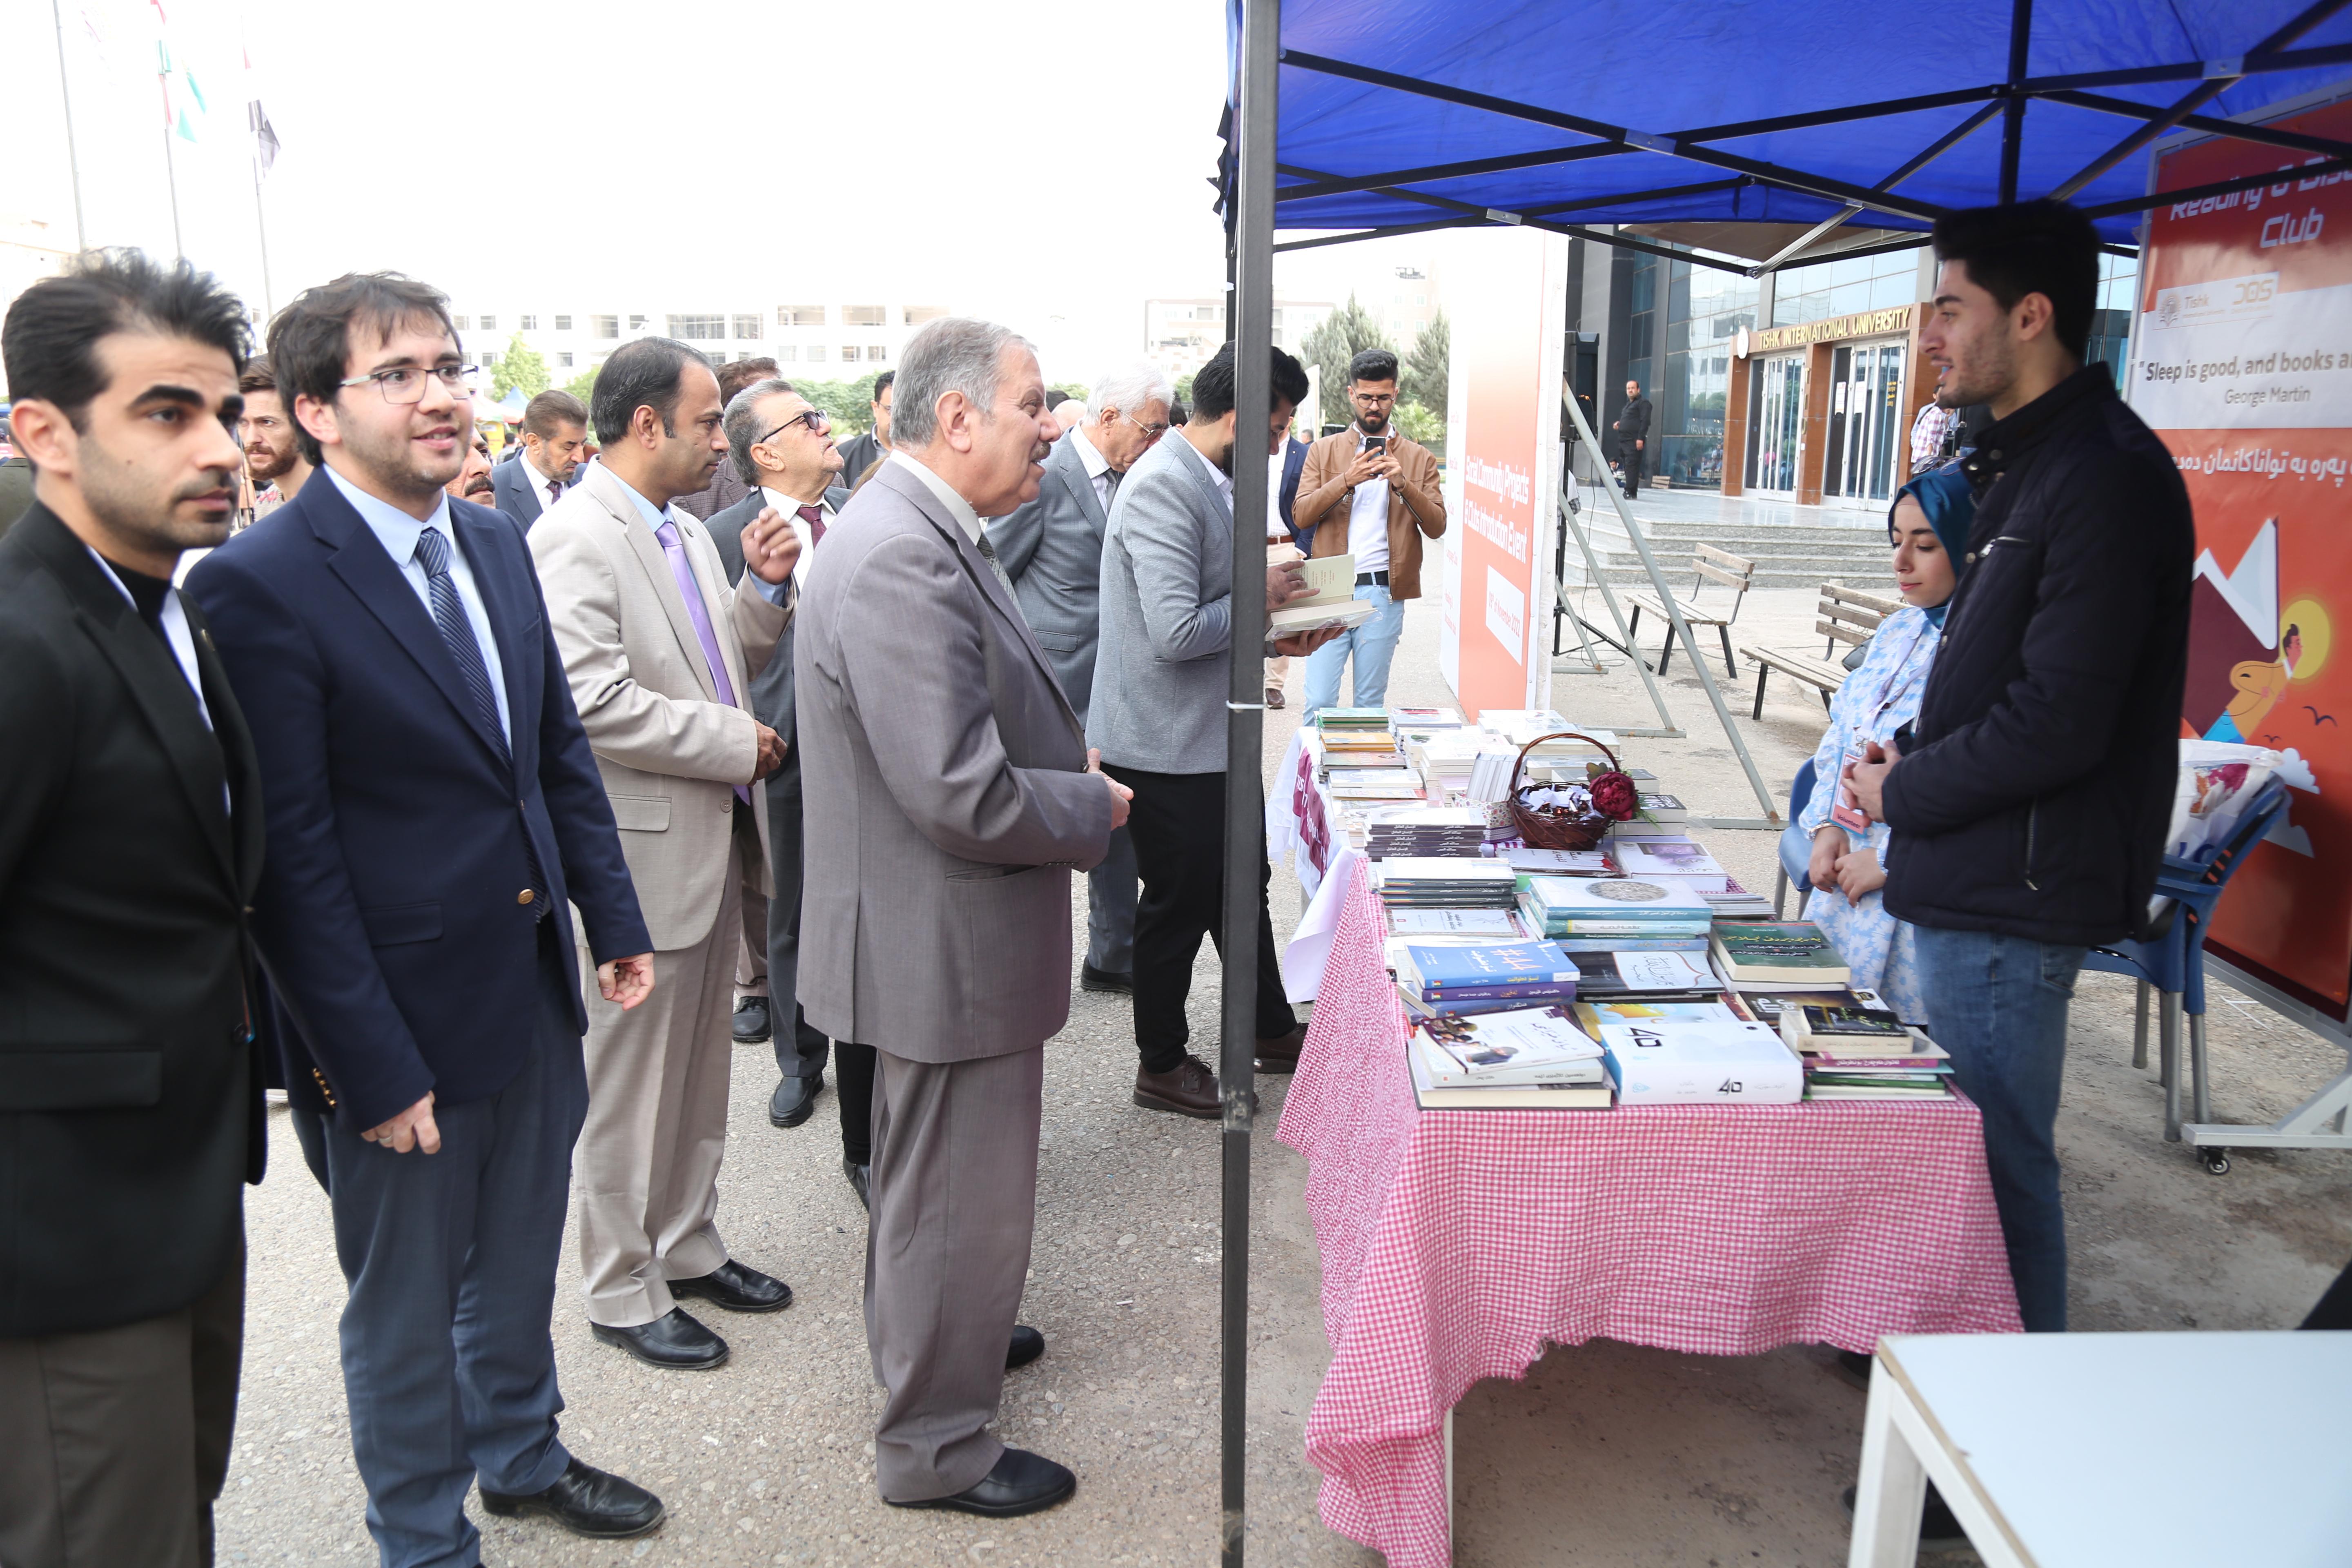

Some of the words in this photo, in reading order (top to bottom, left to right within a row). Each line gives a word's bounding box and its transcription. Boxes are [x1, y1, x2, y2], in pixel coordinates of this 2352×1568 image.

[2260, 207, 2324, 249] Club
[1759, 330, 1781, 350] TISHK
[1783, 318, 1849, 346] INTERNATIONAL
[1852, 307, 1911, 336] UNIVERSITY
[2186, 359, 2197, 379] is
[2199, 356, 2241, 383] good,
[2245, 353, 2277, 375] and
[2281, 350, 2334, 373] books
[2338, 353, 2352, 369] a
[2225, 389, 2266, 408] George
[2270, 386, 2310, 403] Martin
[2290, 457, 2307, 481] بە
[1466, 455, 1479, 485] Social
[1478, 459, 1505, 503] Community
[1504, 464, 1530, 509] Projects
[1468, 500, 1480, 532] Clubs
[1479, 506, 1508, 551] Introduction
[1508, 521, 1527, 564] Event
[1511, 612, 1520, 638] 2022
[1641, 795, 1665, 807] KING
[1657, 795, 1678, 808] STEPHEN
[1838, 814, 1861, 829] Volunteer
[1490, 949, 1544, 971] #44
[1757, 998, 1784, 1013] الله
[1628, 1027, 1667, 1047] 40
[1717, 1077, 1743, 1096] 40
